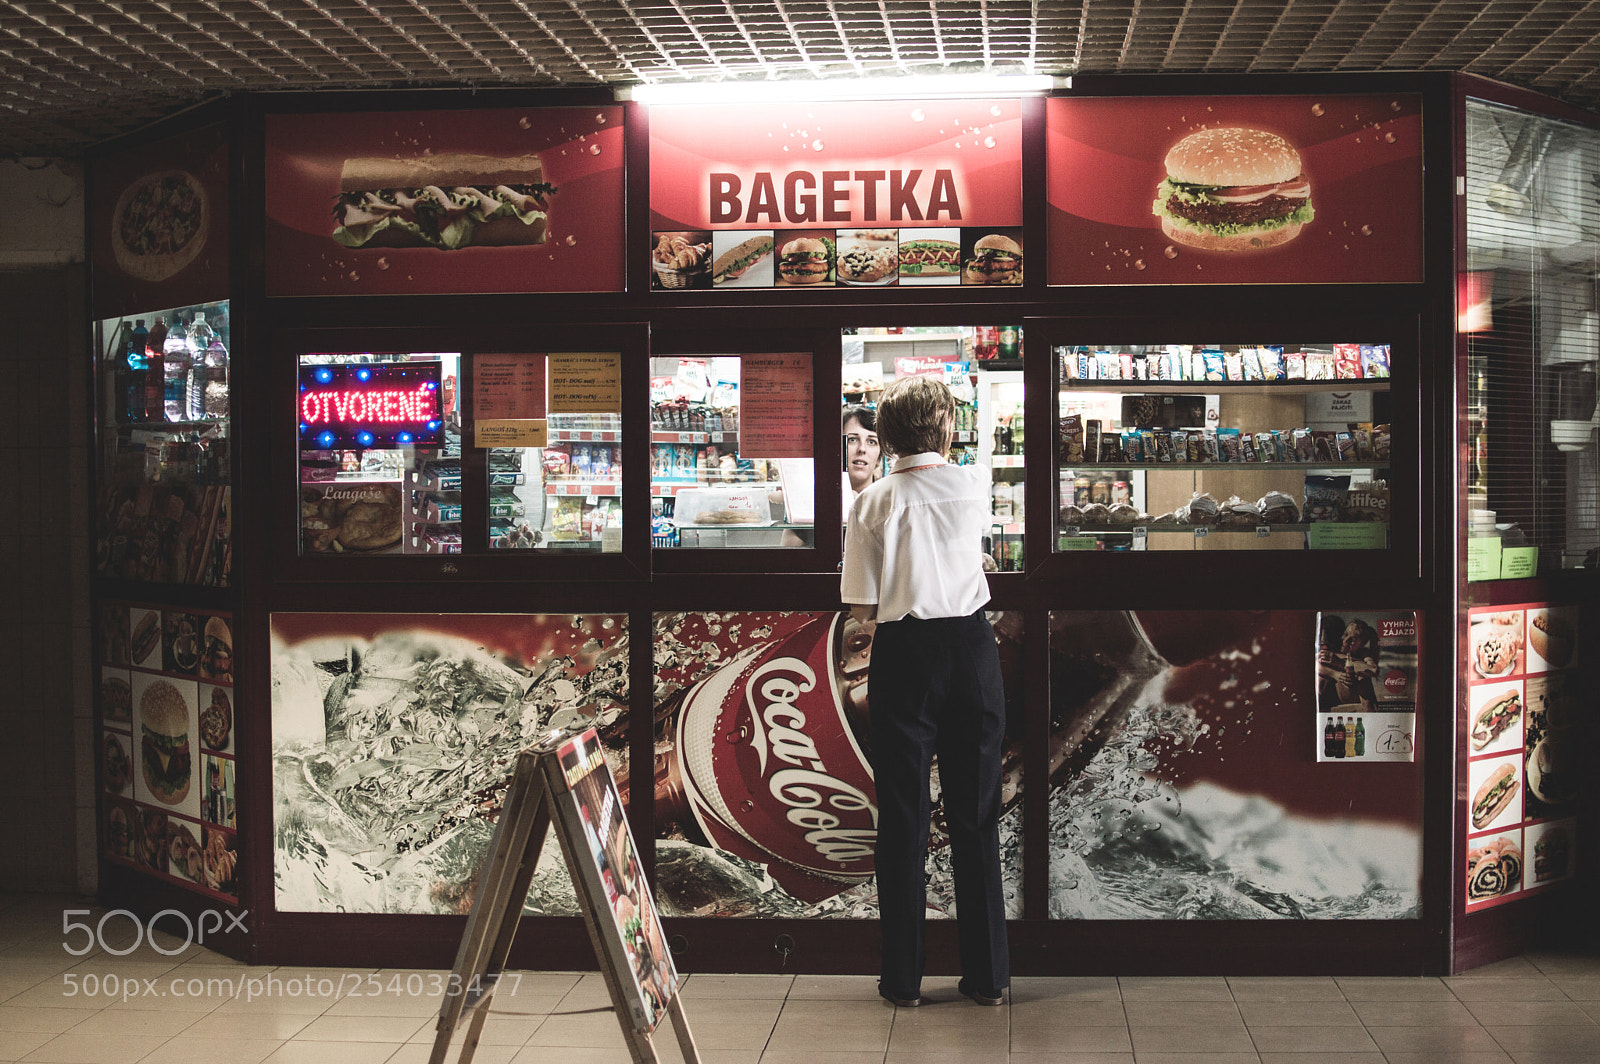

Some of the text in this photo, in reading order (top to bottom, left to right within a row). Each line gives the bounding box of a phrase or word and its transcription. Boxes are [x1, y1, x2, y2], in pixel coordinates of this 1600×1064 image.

[709, 168, 963, 225] BAGETKA
[302, 382, 432, 424] OTVORENÉ
[322, 485, 383, 504] Langoše
[1382, 620, 1415, 628] VYHRAJ
[1383, 628, 1415, 637] ZÁJAZD
[1384, 677, 1406, 686] Coca-Cola
[745, 656, 879, 863] Coca-Cola
